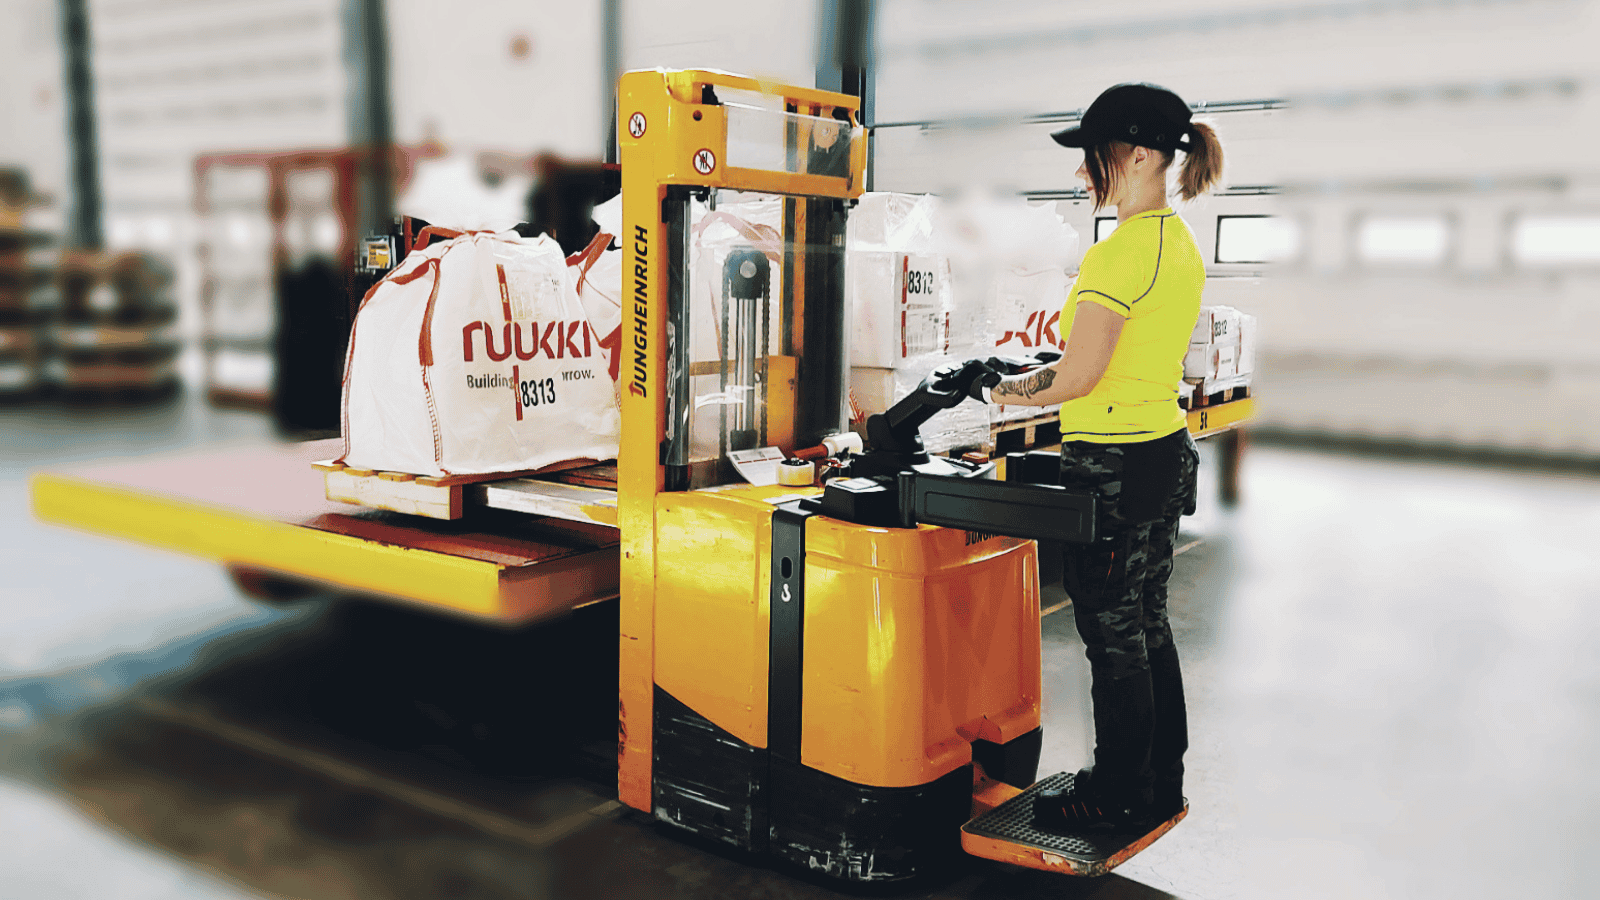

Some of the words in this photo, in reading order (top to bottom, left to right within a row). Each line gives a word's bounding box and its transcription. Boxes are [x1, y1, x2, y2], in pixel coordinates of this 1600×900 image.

[632, 225, 648, 398] JUNGHEINRICH
[466, 373, 515, 390] Building
[520, 378, 556, 408] 8313
